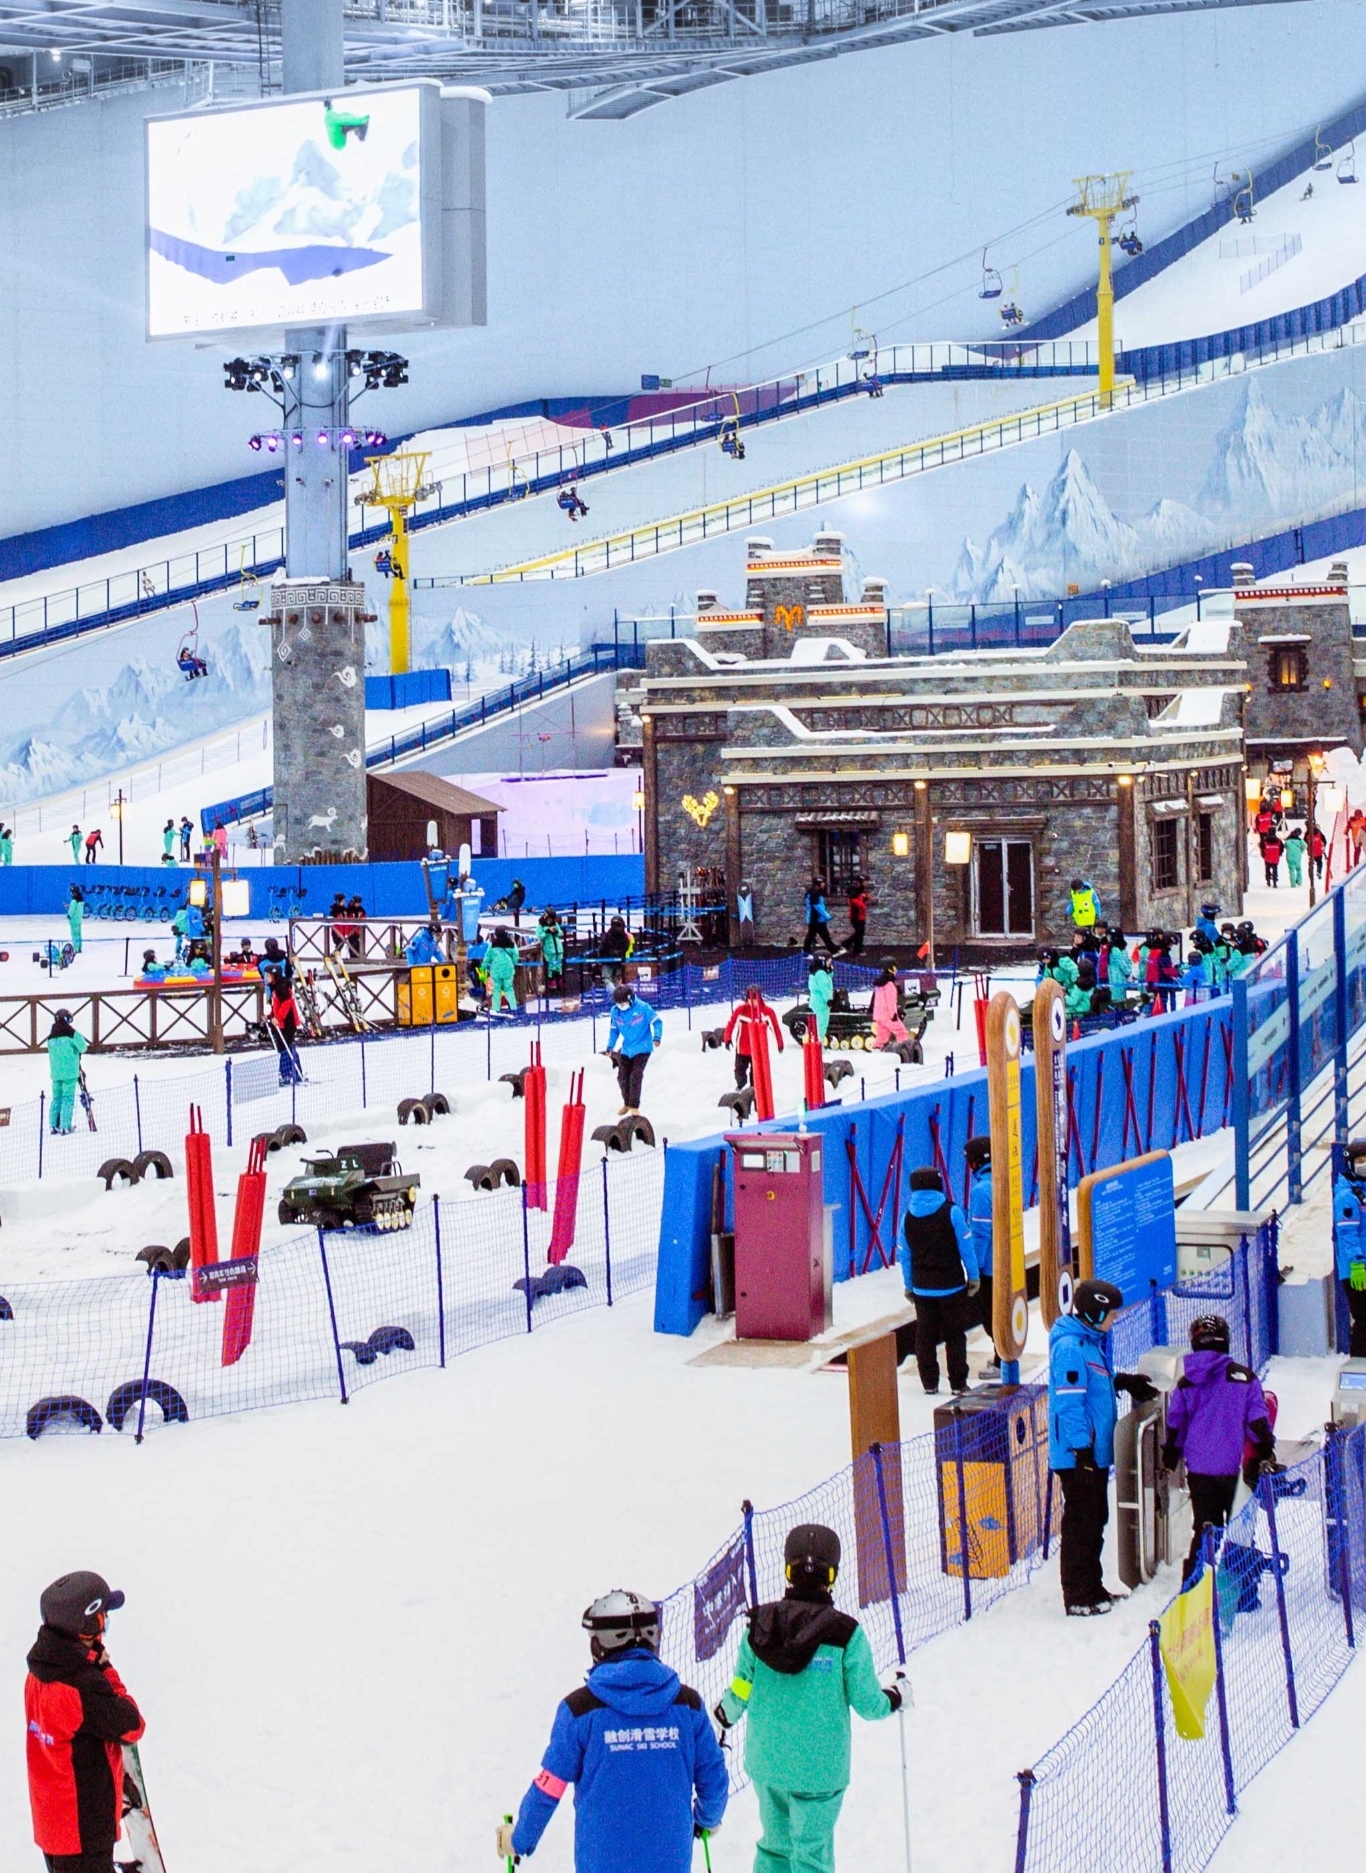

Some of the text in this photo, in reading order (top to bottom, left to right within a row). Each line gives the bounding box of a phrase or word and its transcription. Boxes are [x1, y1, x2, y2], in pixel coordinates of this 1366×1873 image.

[603, 1727, 680, 1744] 融创滑雪学校
[609, 1741, 677, 1752] SUNAC SKI SCHOOL
